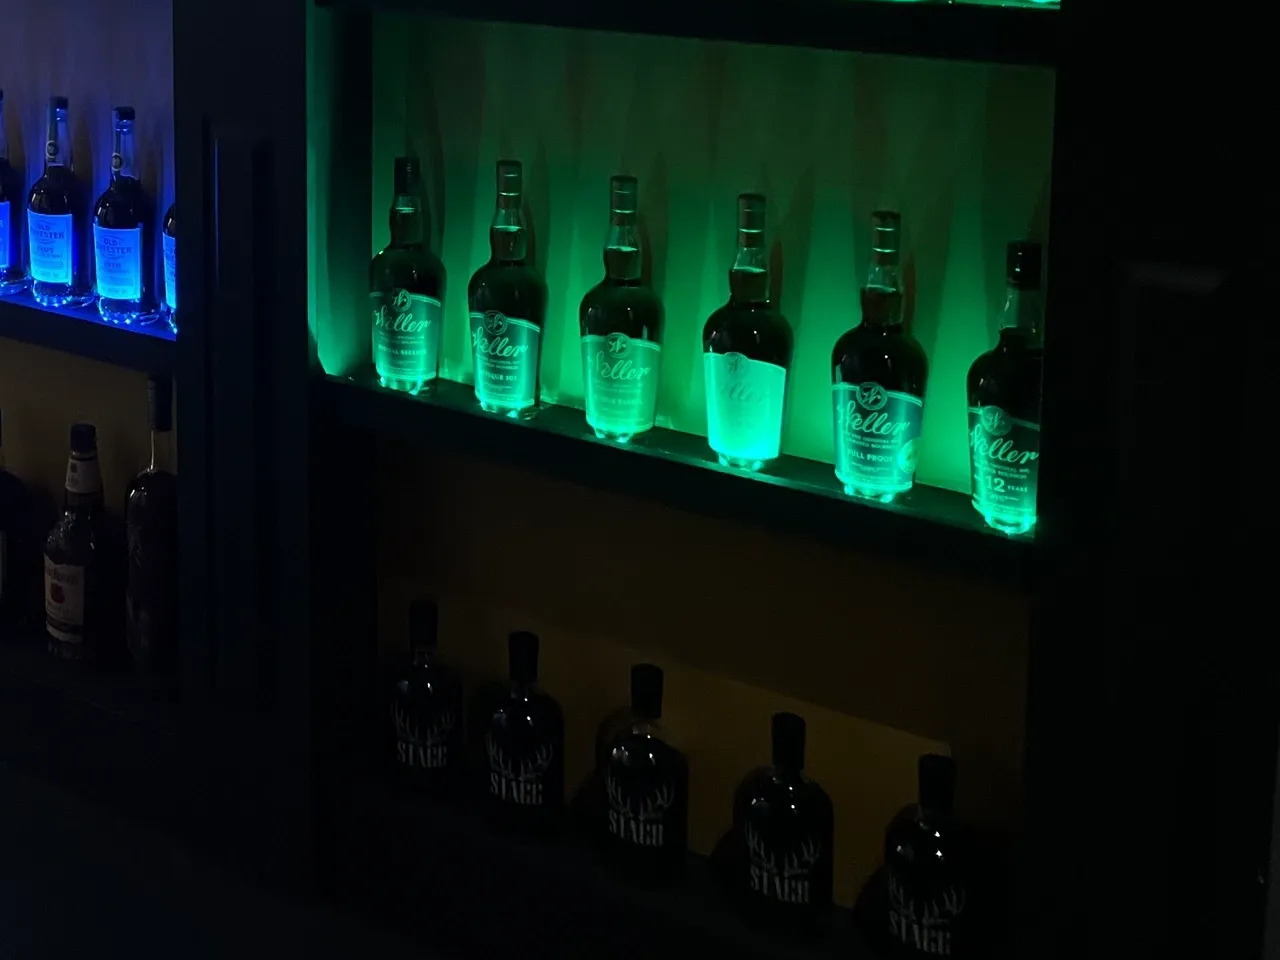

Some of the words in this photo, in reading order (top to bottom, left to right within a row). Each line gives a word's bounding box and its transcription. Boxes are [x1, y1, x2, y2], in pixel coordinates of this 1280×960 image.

[472, 326, 529, 357] Weller
[836, 400, 911, 436] Weller
[970, 423, 1039, 464] Weller
[985, 475, 1006, 493] 12
